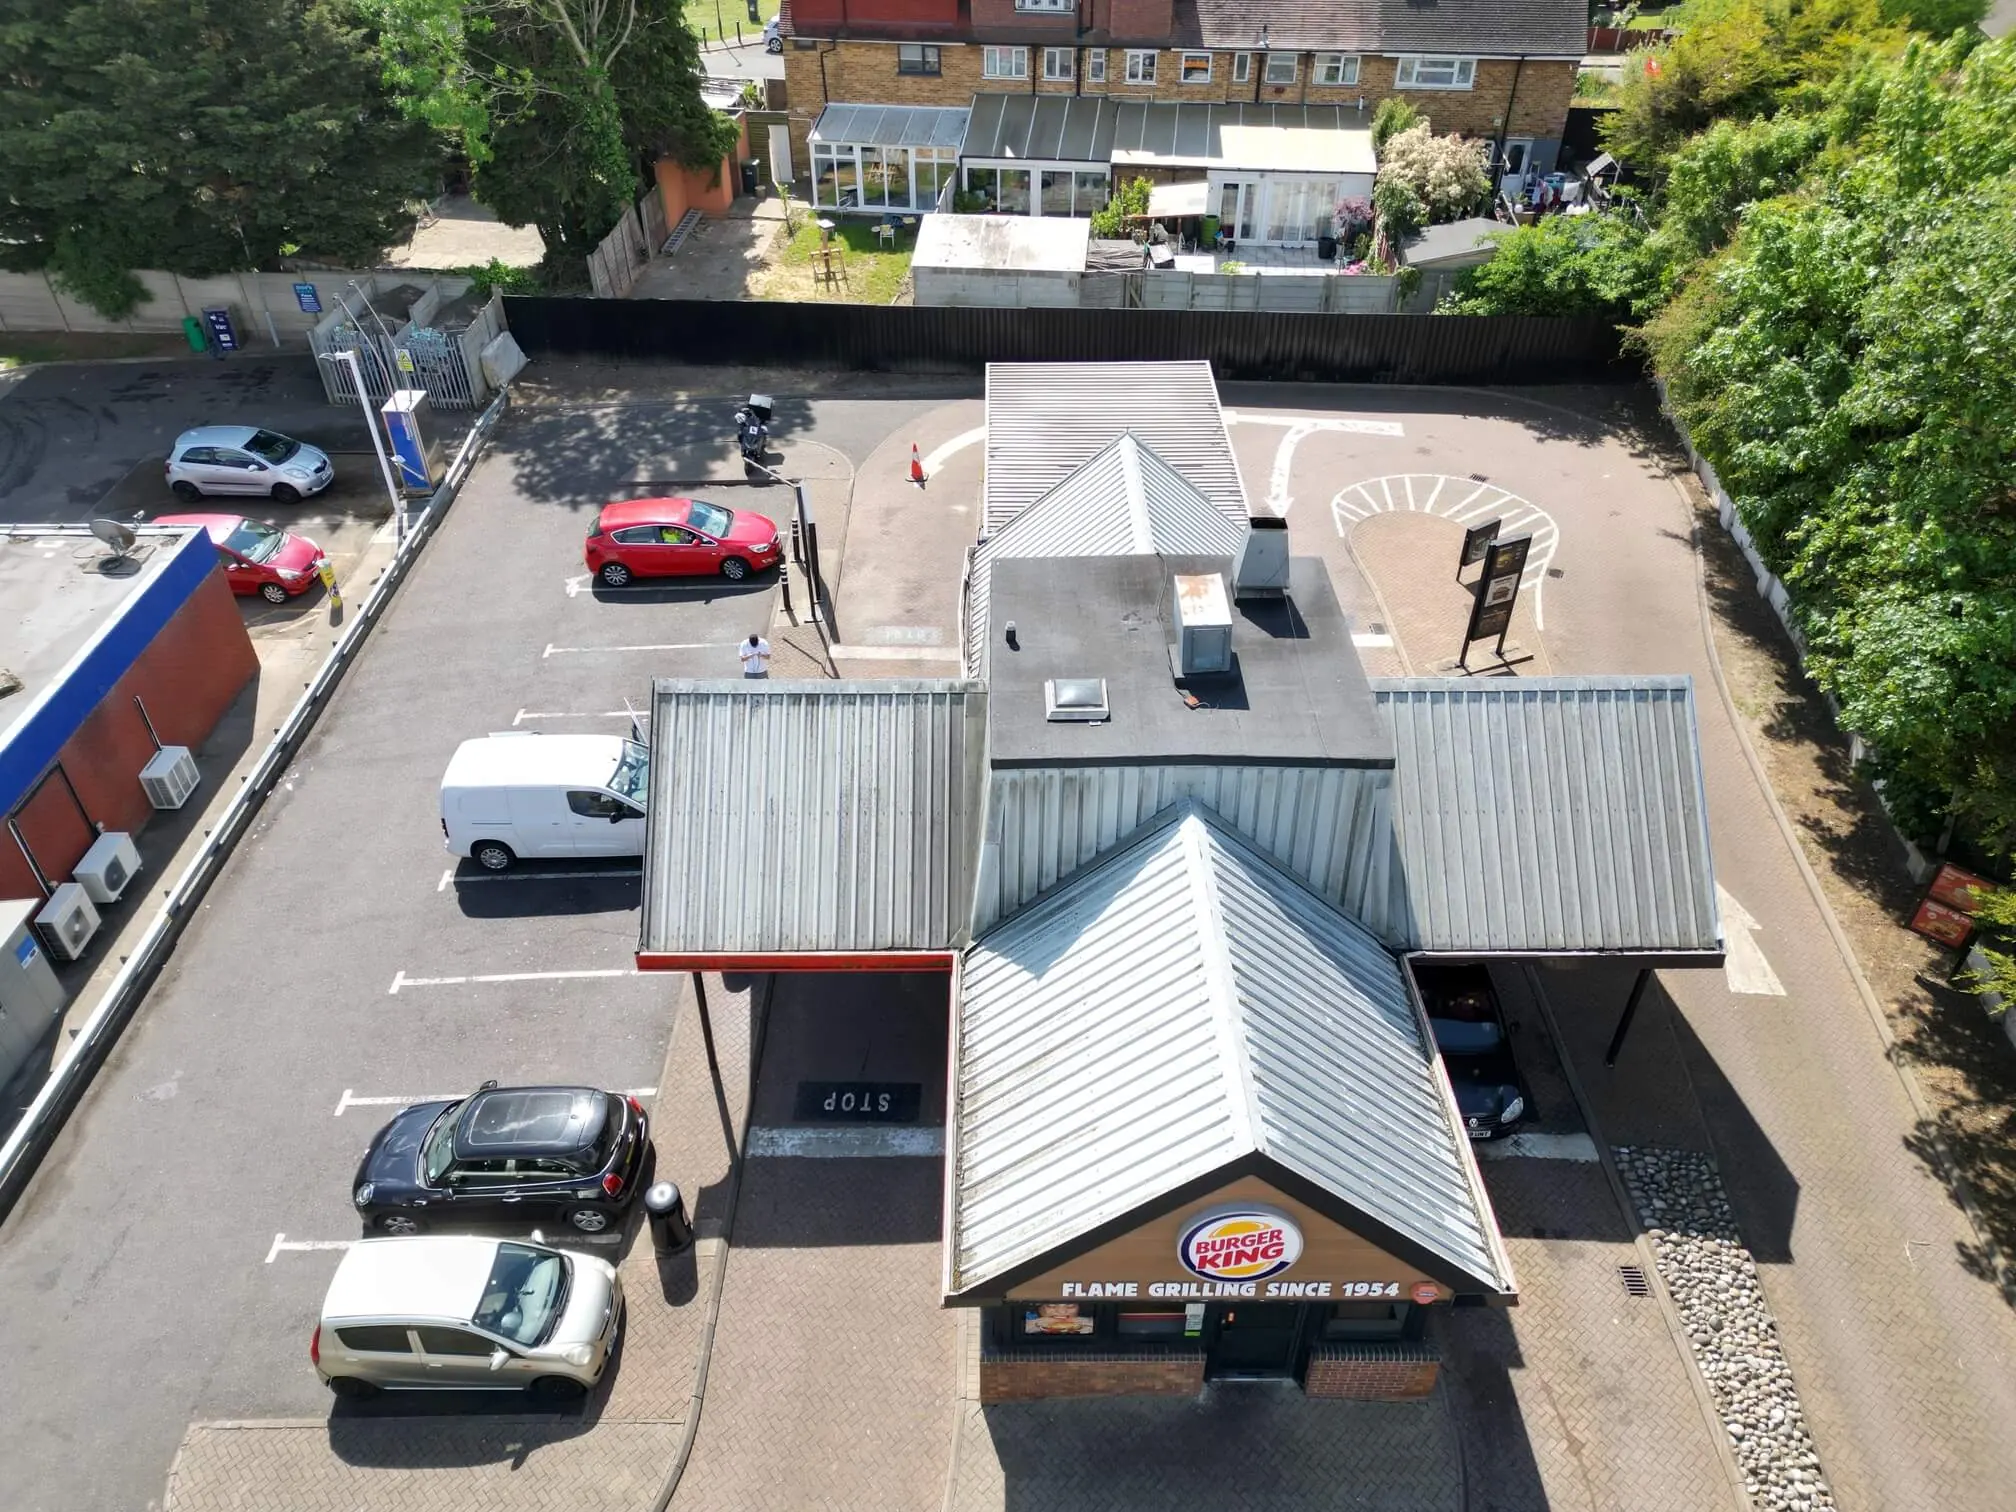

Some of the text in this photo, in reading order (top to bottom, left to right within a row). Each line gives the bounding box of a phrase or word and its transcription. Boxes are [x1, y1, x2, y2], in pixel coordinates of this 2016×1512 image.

[823, 1091, 891, 1112] STOP
[1196, 1229, 1283, 1255] BURGER
[1197, 1242, 1285, 1270] KING
[1062, 1282, 1399, 1297] FLAME GRILLING SINCE 1954
